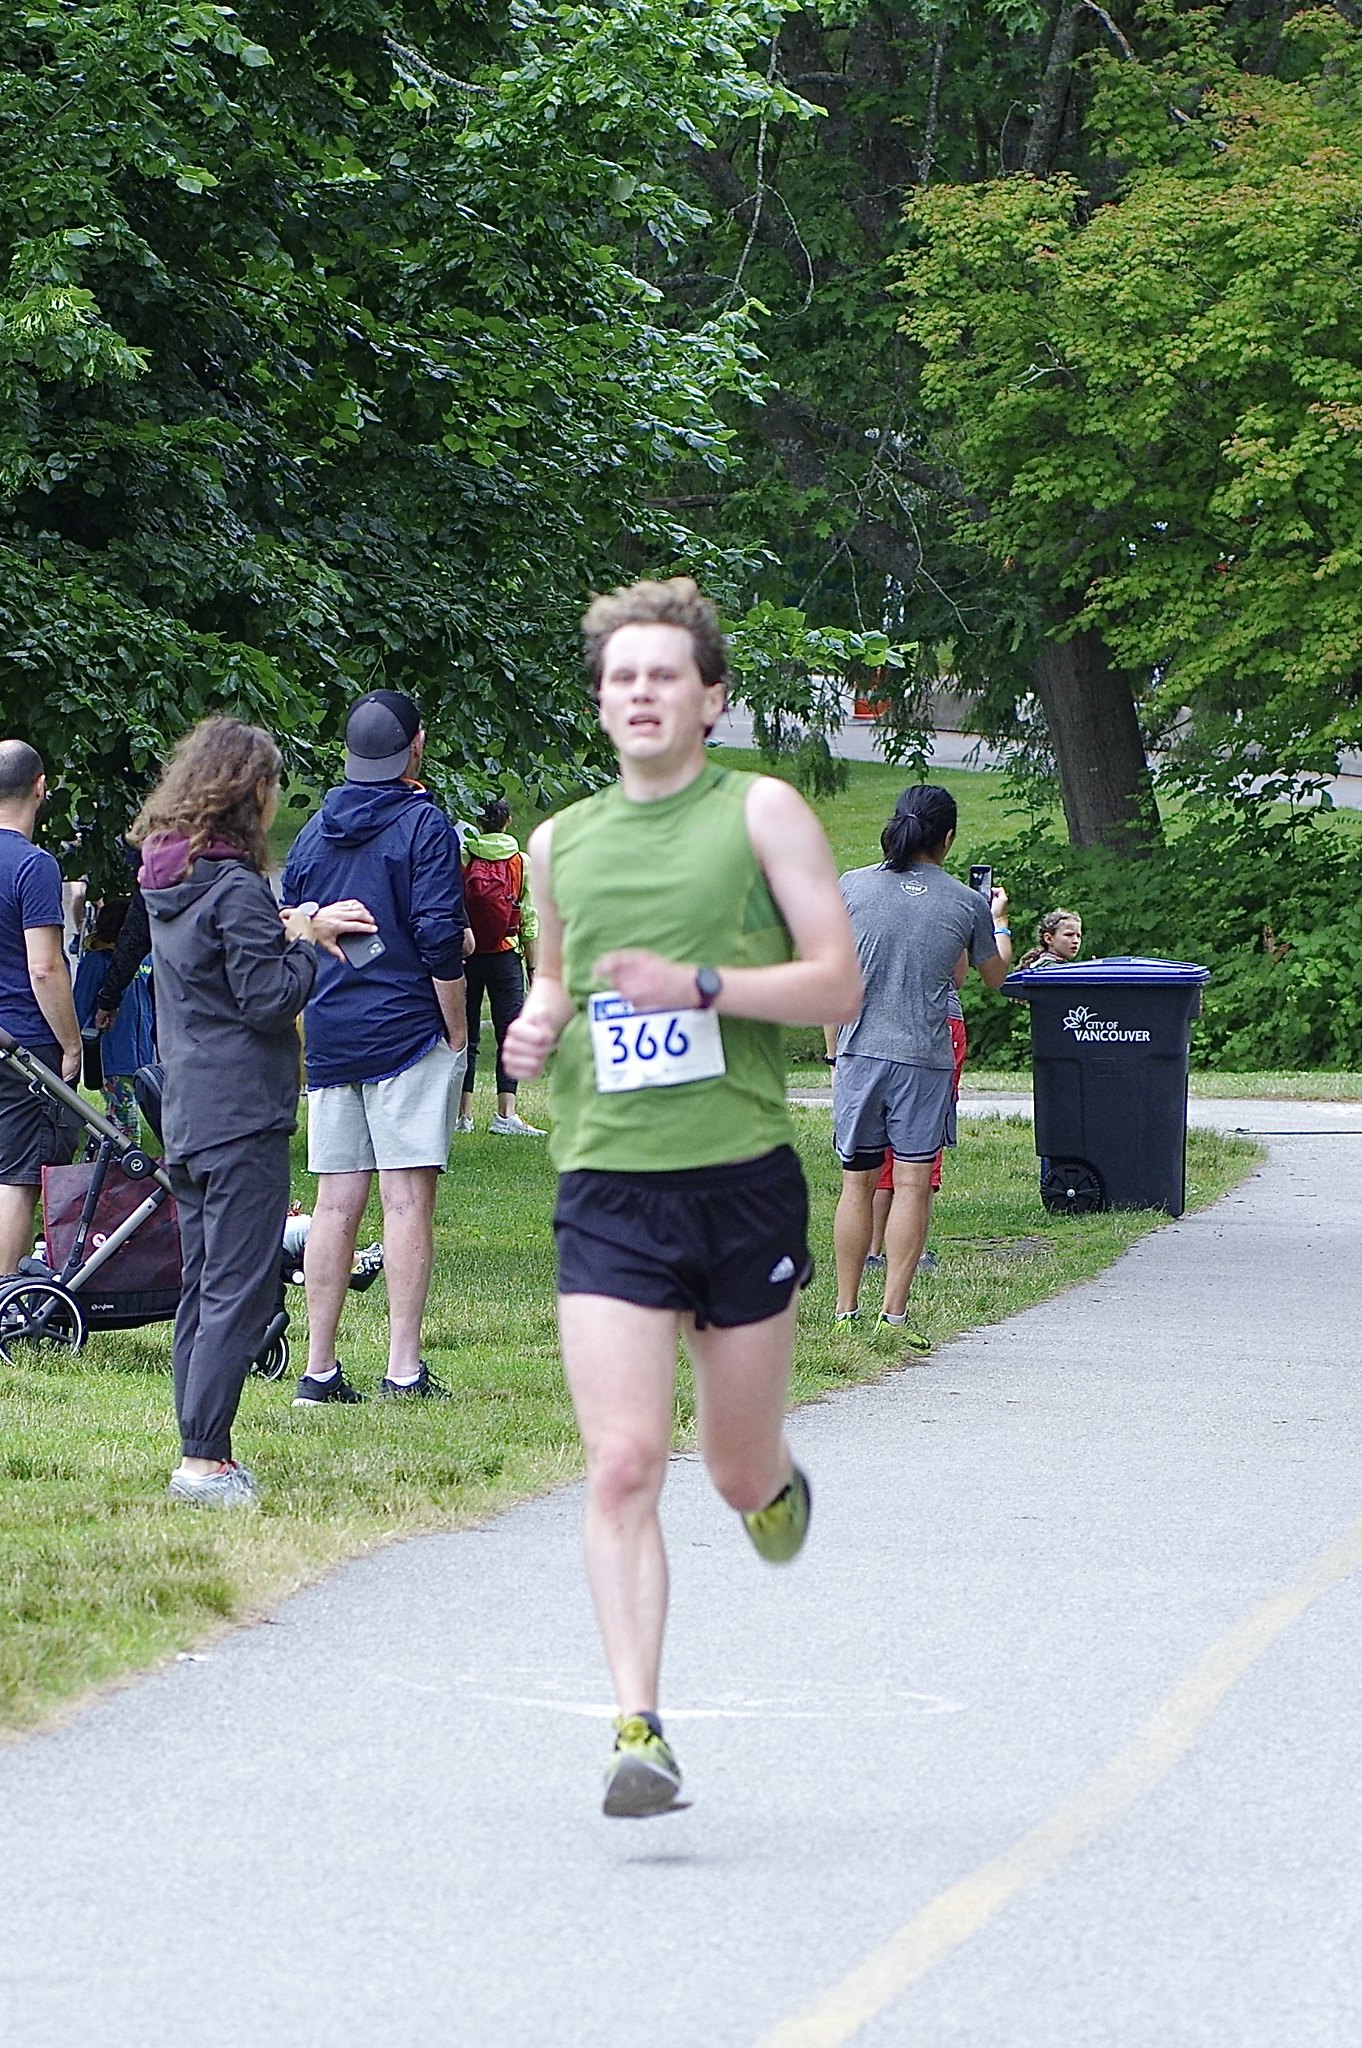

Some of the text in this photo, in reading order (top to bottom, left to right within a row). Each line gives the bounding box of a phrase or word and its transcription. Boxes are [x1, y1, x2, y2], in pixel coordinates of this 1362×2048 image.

[1085, 1021, 1119, 1030] CITY OF
[608, 1017, 689, 1064] 366
[1074, 1030, 1151, 1042] VANCOUVER
